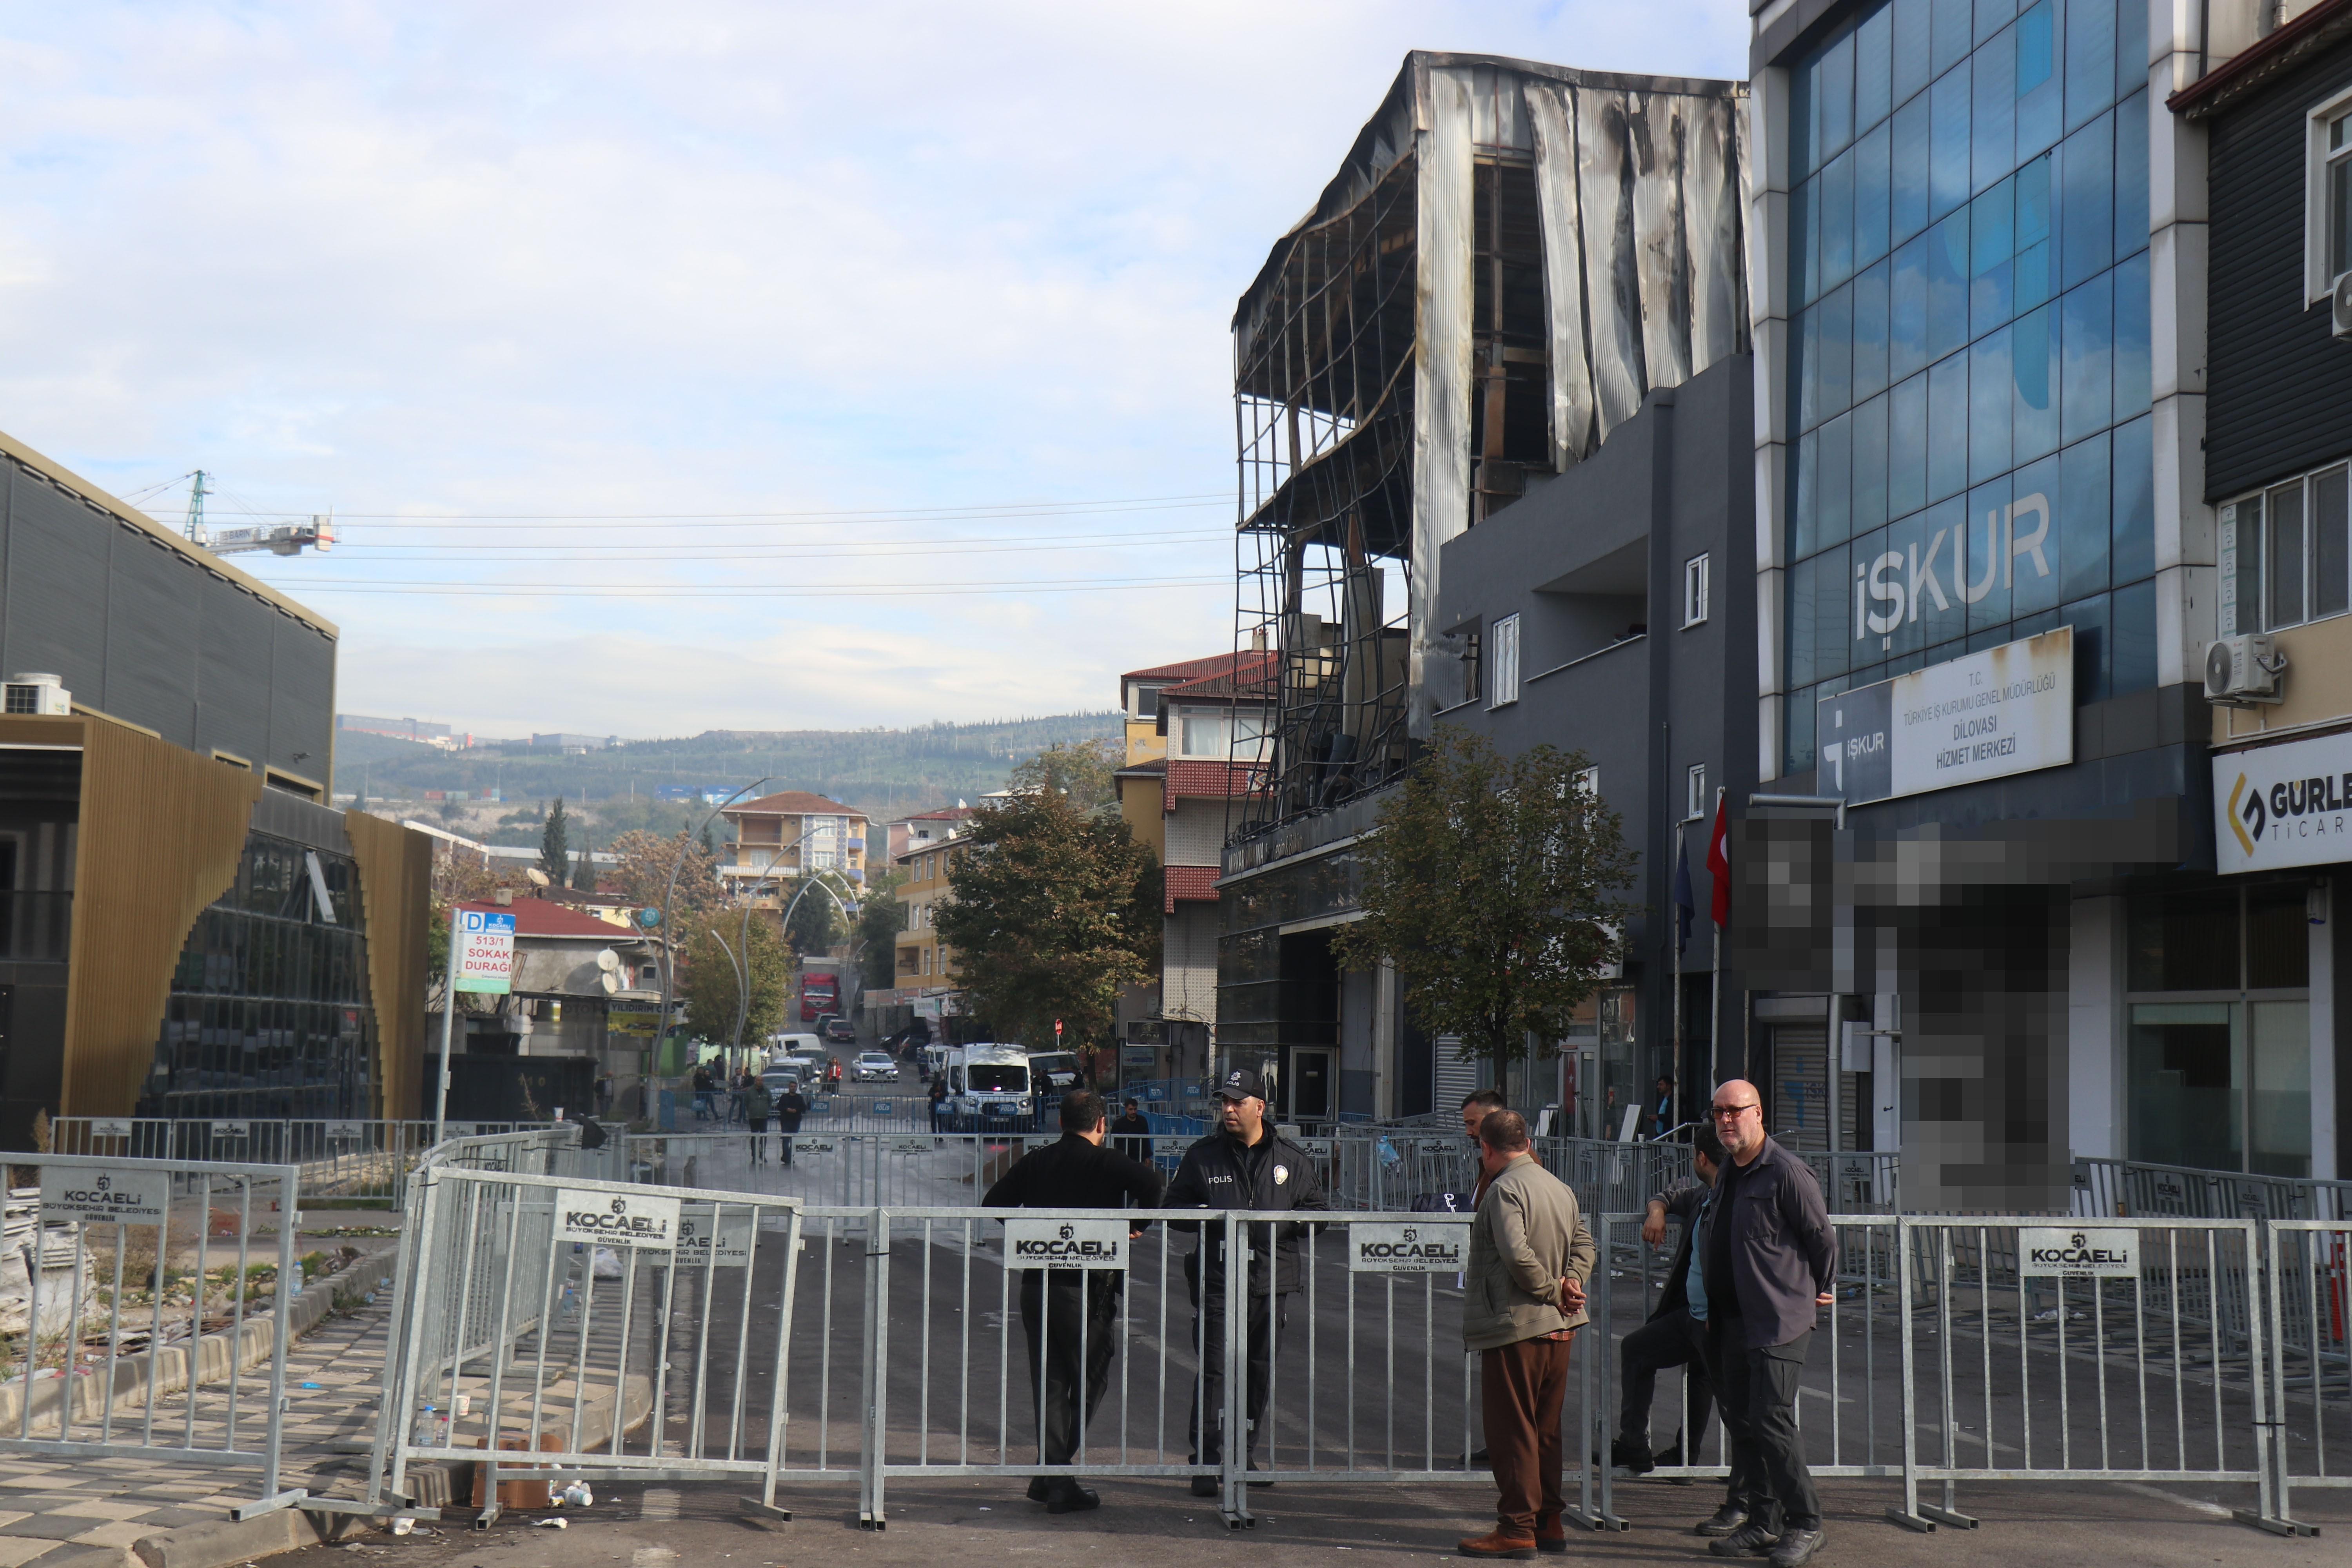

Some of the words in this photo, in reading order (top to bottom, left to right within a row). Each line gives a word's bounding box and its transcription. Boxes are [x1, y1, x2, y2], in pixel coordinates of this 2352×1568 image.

[1969, 671, 1983, 687] T.C.
[1904, 706, 1932, 726] TÜRKİYE
[1934, 702, 1940, 721] İŞ
[1942, 696, 1974, 716] KURUMU
[1976, 690, 2000, 708] GENEL
[2003, 672, 2055, 701] MÜDÜRLÜĞÜ
[1953, 715, 1997, 741] DİLOVASI
[1936, 746, 1970, 769] HİZMET
[1973, 732, 2016, 762] MERKEZİ
[468, 913, 482, 930] D
[476, 936, 504, 946] 513/1
[468, 948, 510, 959] SOKAK
[465, 961, 511, 972] DURAĞI
[657, 1005, 675, 1014] OO
[64, 1190, 142, 1205] KOCAELi
[1016, 1240, 1116, 1255] KOCAELi
[1361, 1243, 1459, 1258] KOCAELi
[2031, 1249, 2127, 1263] KOCAELi
